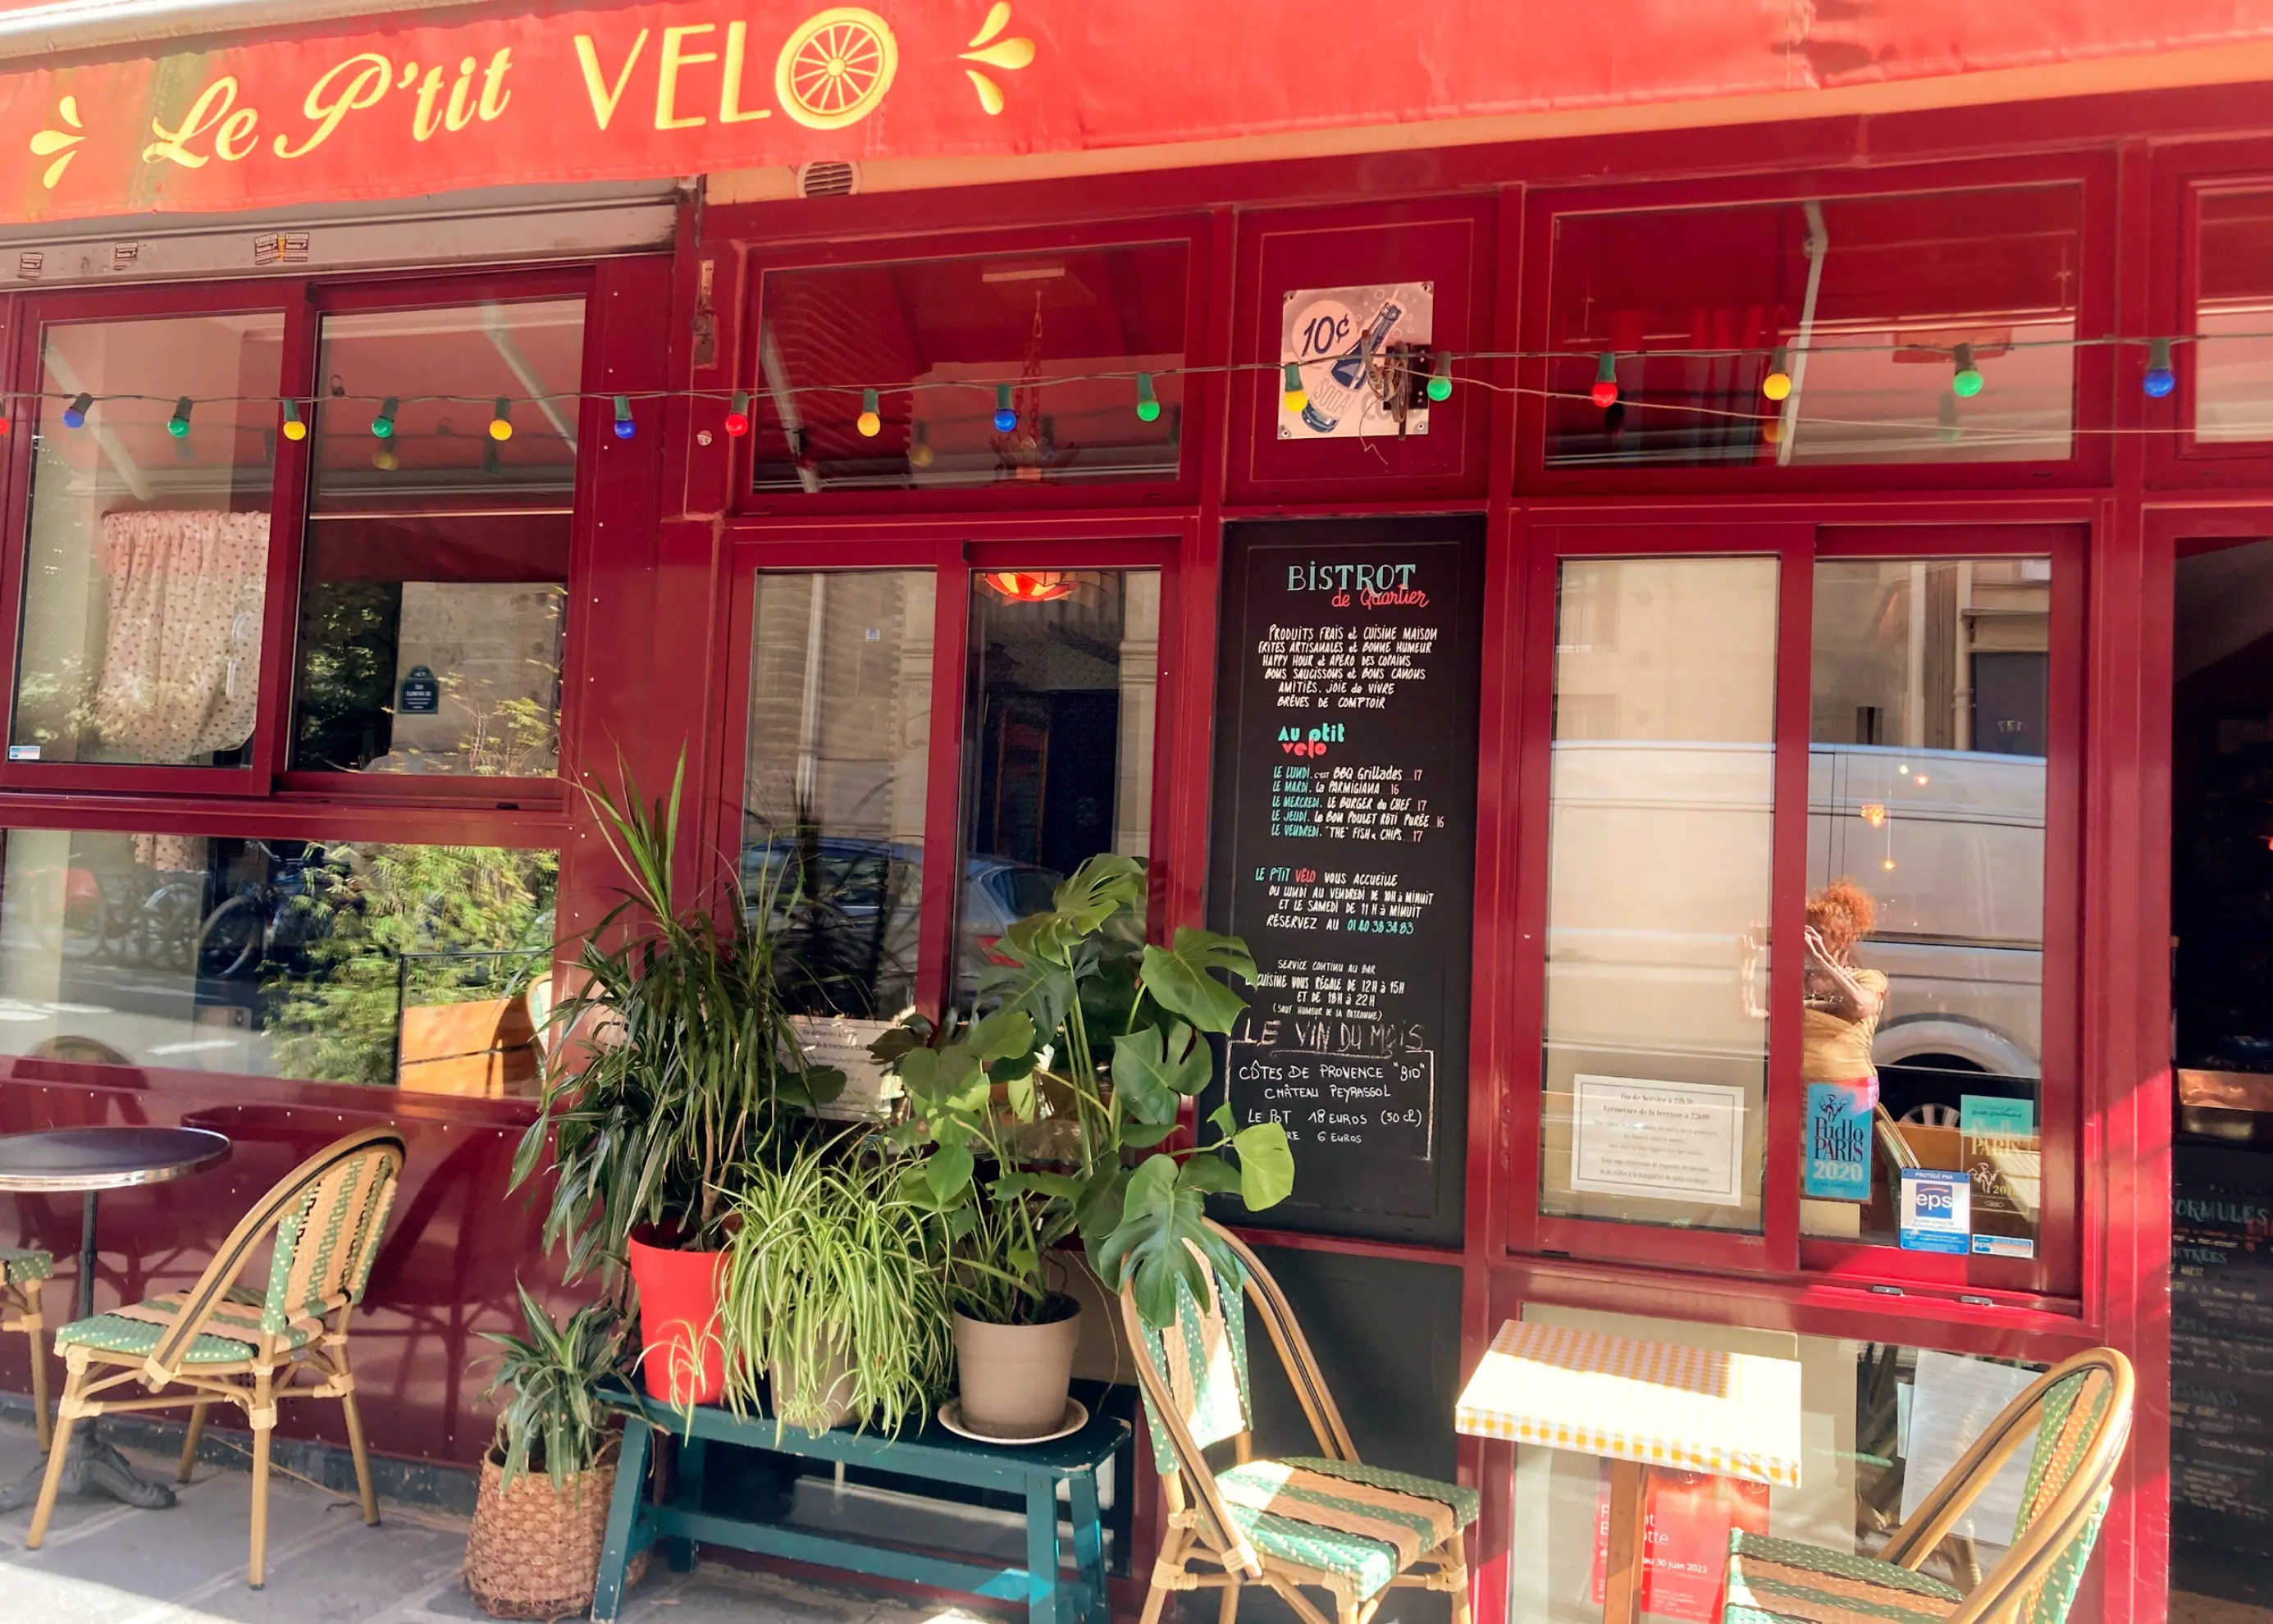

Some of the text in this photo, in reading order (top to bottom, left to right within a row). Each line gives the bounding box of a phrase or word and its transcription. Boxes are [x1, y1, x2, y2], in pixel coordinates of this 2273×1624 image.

[142, 76, 258, 169] Le
[273, 48, 512, 158] P'tit
[1332, 584, 1431, 610] de Quartier
[1269, 623, 1314, 641] PRODUITS
[1320, 624, 1344, 641] FRAIS
[1363, 623, 1397, 640] CUISINE
[1403, 625, 1438, 641] MAISON
[1258, 641, 1285, 654] FRITES
[1289, 640, 1344, 654] ARTISANALES
[1362, 641, 1392, 654] BONNE
[1396, 641, 1433, 654] HUMEUR
[1262, 654, 1289, 667] HAPPY
[1292, 655, 1314, 667] HOUR
[1362, 655, 1375, 667] DES
[1377, 654, 1411, 667] COPAINS
[1265, 668, 1287, 680] BONS
[1293, 666, 1344, 680] SAUCISSONS
[1362, 667, 1385, 680] BONS
[1391, 667, 1426, 680] CANONS
[1326, 680, 1348, 694] JOIE
[1351, 682, 1362, 694] de
[1368, 681, 1394, 695] VIVRE
[1317, 697, 1329, 708] DE
[1338, 696, 1385, 709] COMPTOIR
[1273, 765, 1283, 778] LE
[1333, 766, 1353, 780] BBQ
[1358, 764, 1403, 781] Grillades
[1414, 769, 1423, 781] 17
[1272, 780, 1281, 792] LE
[1328, 779, 1381, 794] PARMIGIANA
[1391, 783, 1399, 795] 16
[1271, 795, 1280, 807] LE
[1327, 796, 1336, 809] LE
[1339, 796, 1373, 810] BURGER
[1376, 798, 1387, 810] du
[1390, 797, 1412, 811] CHEF
[1417, 800, 1427, 812] 17
[1271, 810, 1280, 821] LE
[1326, 810, 1344, 823] BON
[1348, 810, 1377, 825] POULET
[1436, 815, 1445, 828] 16
[1271, 823, 1280, 836] LE
[1352, 826, 1371, 841] FISH
[1380, 827, 1403, 841] CHIPS
[1413, 830, 1423, 842] 17
[1255, 867, 1266, 882] LE
[1324, 871, 1347, 884] VOUS
[1353, 871, 1399, 887] ACCUEILLE
[1268, 884, 1280, 896] DU
[1283, 884, 1308, 898] LUNDI
[1312, 887, 1325, 899] AU
[1330, 886, 1366, 901] VENDREDI
[1371, 889, 1379, 901] DE
[1405, 890, 1435, 906] MINUIT
[1278, 899, 1289, 910] ET
[1294, 899, 1303, 912] LE
[1308, 900, 1339, 913] SAMEDI
[1345, 901, 1356, 914] DE
[1389, 903, 1422, 918] MINUIT
[1267, 913, 1317, 929] RÉSERVEZ
[1326, 918, 1340, 931] AU
[1277, 958, 1308, 971] SERVICE
[1348, 963, 1358, 974] AU
[1361, 963, 1376, 974] BAR
[1257, 971, 1288, 988] CUISINE
[1291, 975, 1310, 990] VOUS
[1346, 979, 1357, 992] DE
[1362, 979, 1378, 993] 12H
[1390, 980, 1405, 994] 15H
[1297, 991, 1308, 1002] ET
[1311, 992, 1321, 1003] DE
[1244, 1017, 1426, 1052] LE VIN DU MOIS
[1239, 1060, 1282, 1080] CÔTES
[1288, 1065, 1310, 1079] DE
[1320, 1065, 1384, 1079] PROVENCE
[1264, 1084, 1391, 1102] CHÂTEAU PEYRASSOL
[1248, 1108, 1262, 1124] LE
[1270, 1109, 1291, 1124] POT
[1308, 1108, 1325, 1124] 18
[1329, 1113, 1367, 1124] EUROS
[1317, 1130, 1362, 1144] 6 EUROS
[1814, 1116, 1864, 1142] Pudlo
[1814, 1138, 1864, 1163] PARIS
[1813, 1160, 1864, 1183] 2020
[1915, 1193, 1953, 1211] eps
[2175, 1198, 2269, 1226] ORMULES
